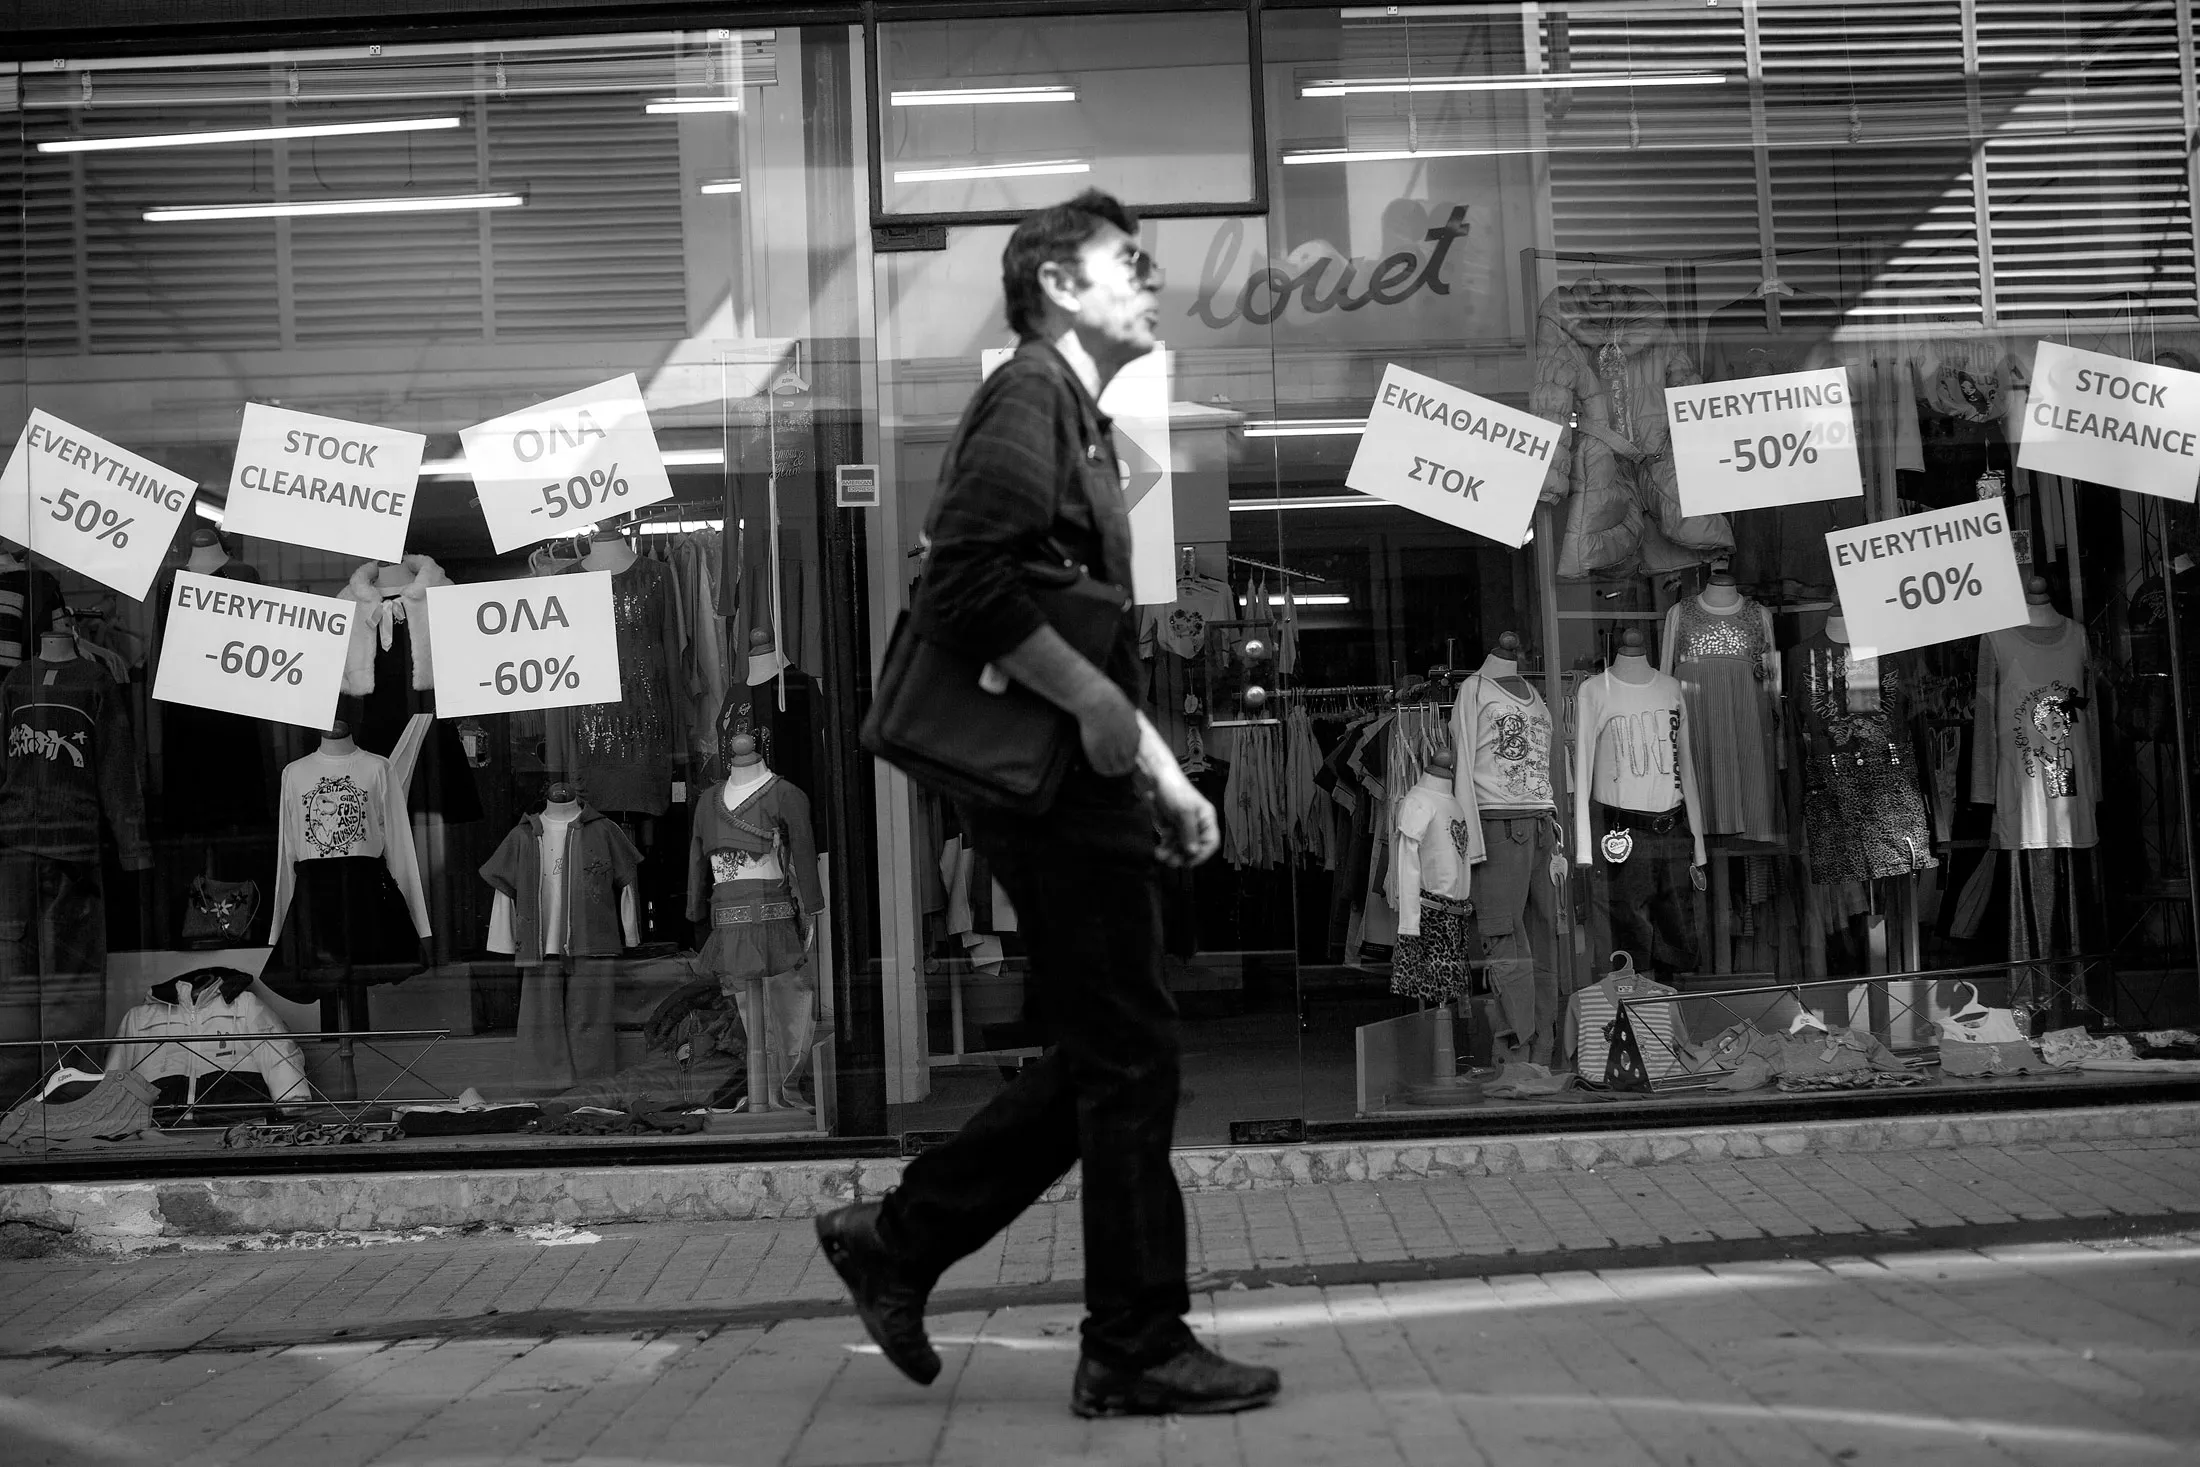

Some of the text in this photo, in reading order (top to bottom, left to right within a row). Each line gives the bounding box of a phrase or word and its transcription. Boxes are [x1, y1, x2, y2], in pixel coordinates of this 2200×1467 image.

[1187, 205, 1470, 329] louet
[1674, 383, 1842, 423] EVERYTHING
[2076, 369, 2168, 408] STOCK
[513, 409, 607, 463] ΟΛΑ
[1382, 383, 1550, 461] ΕΚΚΑΘΑΡΙΣΗ
[2034, 404, 2196, 456] CLEARANCE
[27, 424, 185, 512] EVERYTHING
[284, 430, 378, 468] STOCK
[1719, 430, 1818, 472] -50%
[241, 465, 406, 517] CLEARANCE
[531, 463, 628, 518] -50%
[1408, 456, 1485, 502] ΣΤΟΚ
[40, 492, 129, 548] -50%
[1835, 513, 2002, 566] EVERYTHING
[1885, 563, 1982, 610] -60%
[178, 585, 347, 635] EVERYTHING
[477, 596, 569, 635] ΟΛΑ
[206, 641, 304, 685] -60%
[480, 655, 580, 695] -60%
[337, 803, 359, 817] FUN
[337, 815, 359, 828] AND
[332, 824, 356, 845] MUSIC
